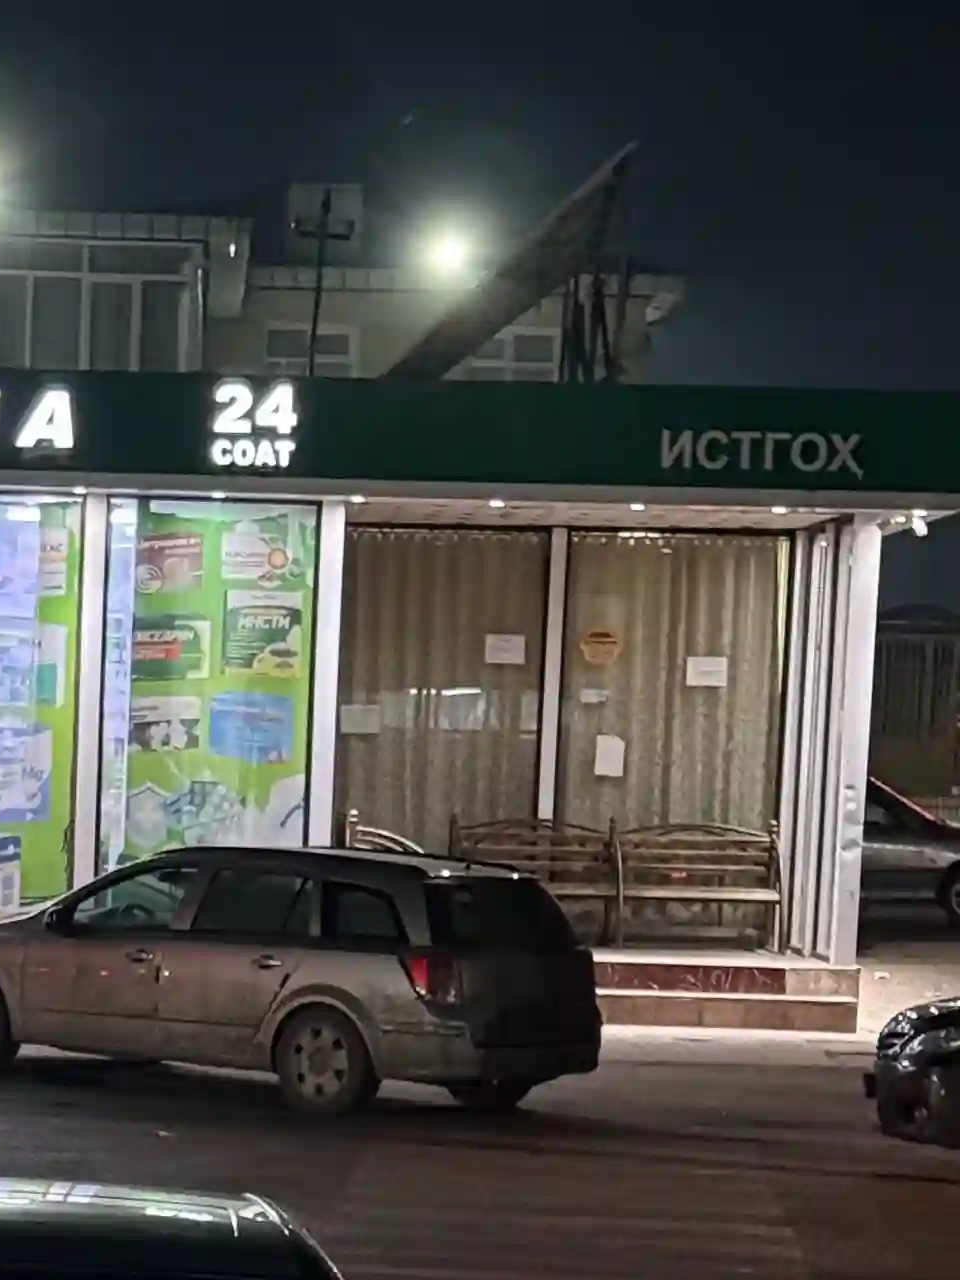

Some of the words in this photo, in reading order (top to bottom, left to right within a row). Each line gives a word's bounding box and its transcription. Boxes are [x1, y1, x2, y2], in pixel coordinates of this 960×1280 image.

[212, 384, 298, 434] 24
[211, 439, 296, 467] СОАТ
[660, 428, 864, 481] ИСТГОҲ
